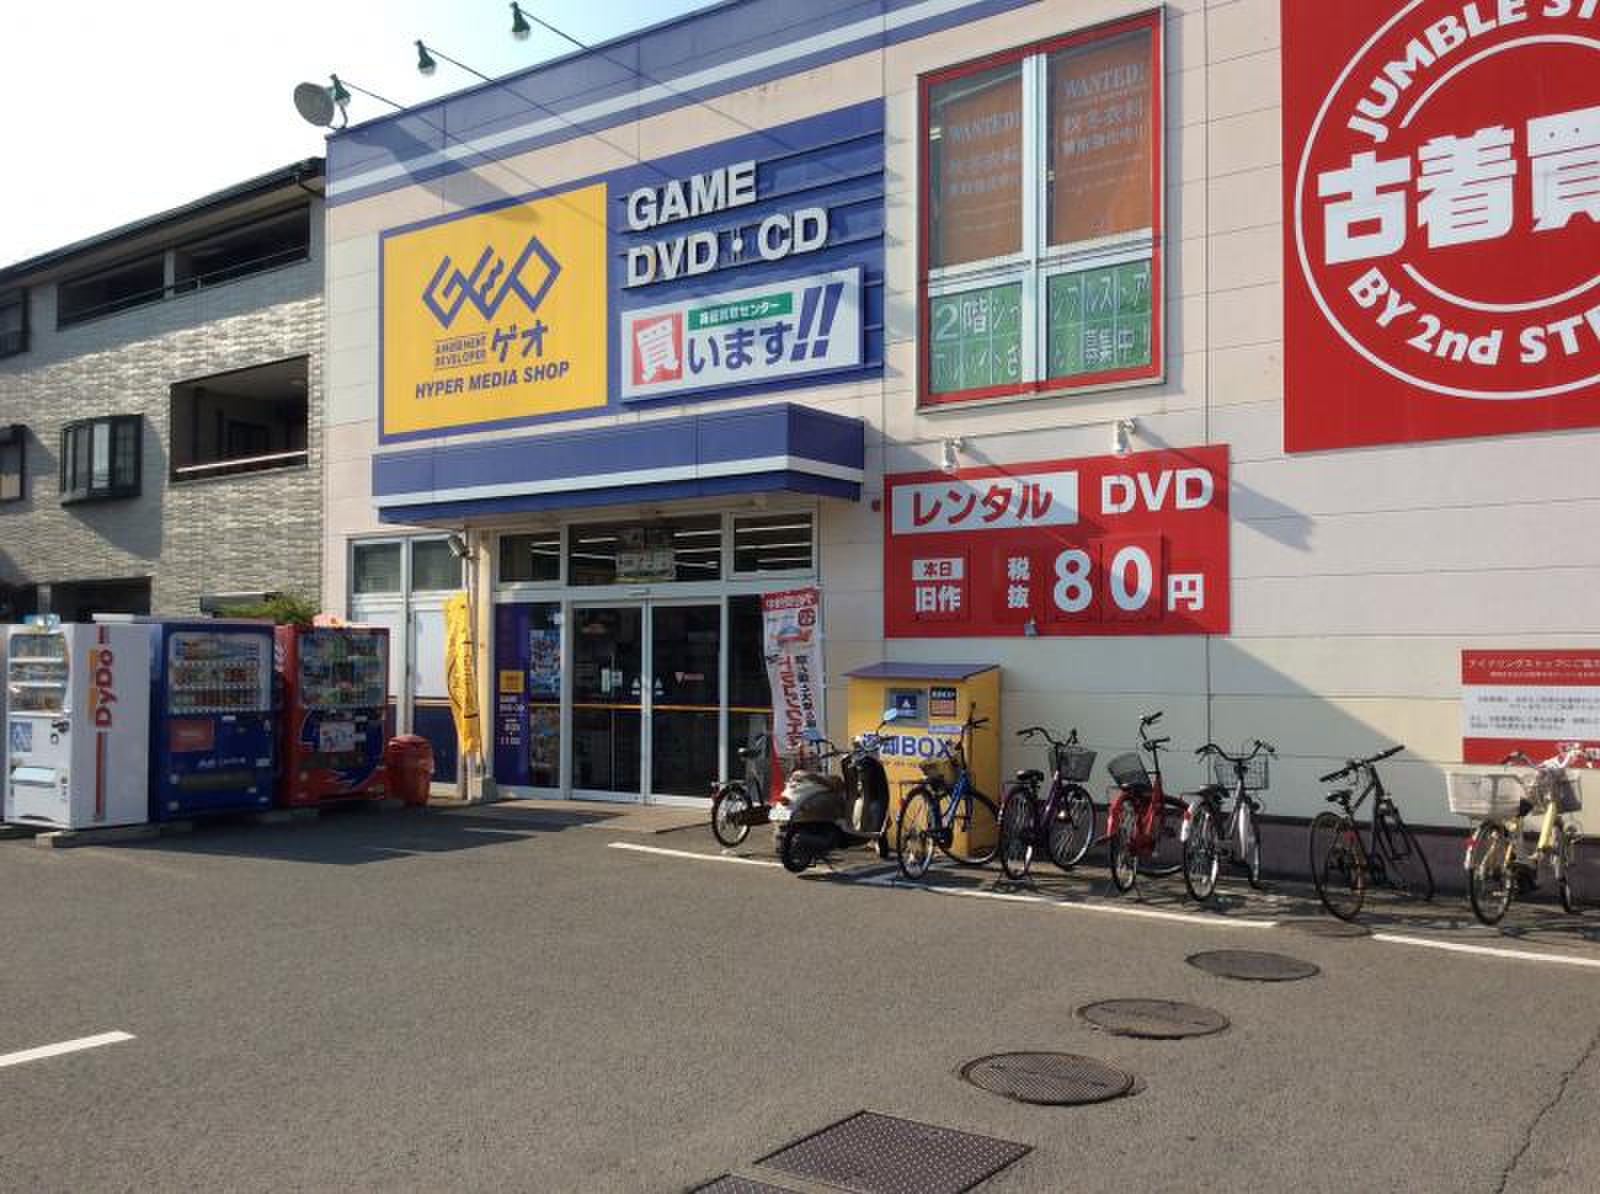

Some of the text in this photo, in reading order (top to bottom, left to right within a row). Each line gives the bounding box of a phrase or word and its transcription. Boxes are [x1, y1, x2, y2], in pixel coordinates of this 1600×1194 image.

[1347, 0, 1527, 143] JUMBLE
[627, 160, 757, 231] GAME
[1318, 106, 1600, 265] 古着買
[490, 320, 549, 363] ゲオ
[1347, 266, 1417, 328] BY
[1407, 313, 1503, 366] 2nd
[415, 361, 570, 399] HYPER MEDIA SHOP
[913, 468, 1214, 527] レンタル DVD
[915, 586, 961, 612] 旧作
[923, 561, 953, 577] 本日
[96, 649, 117, 727] DyDo
